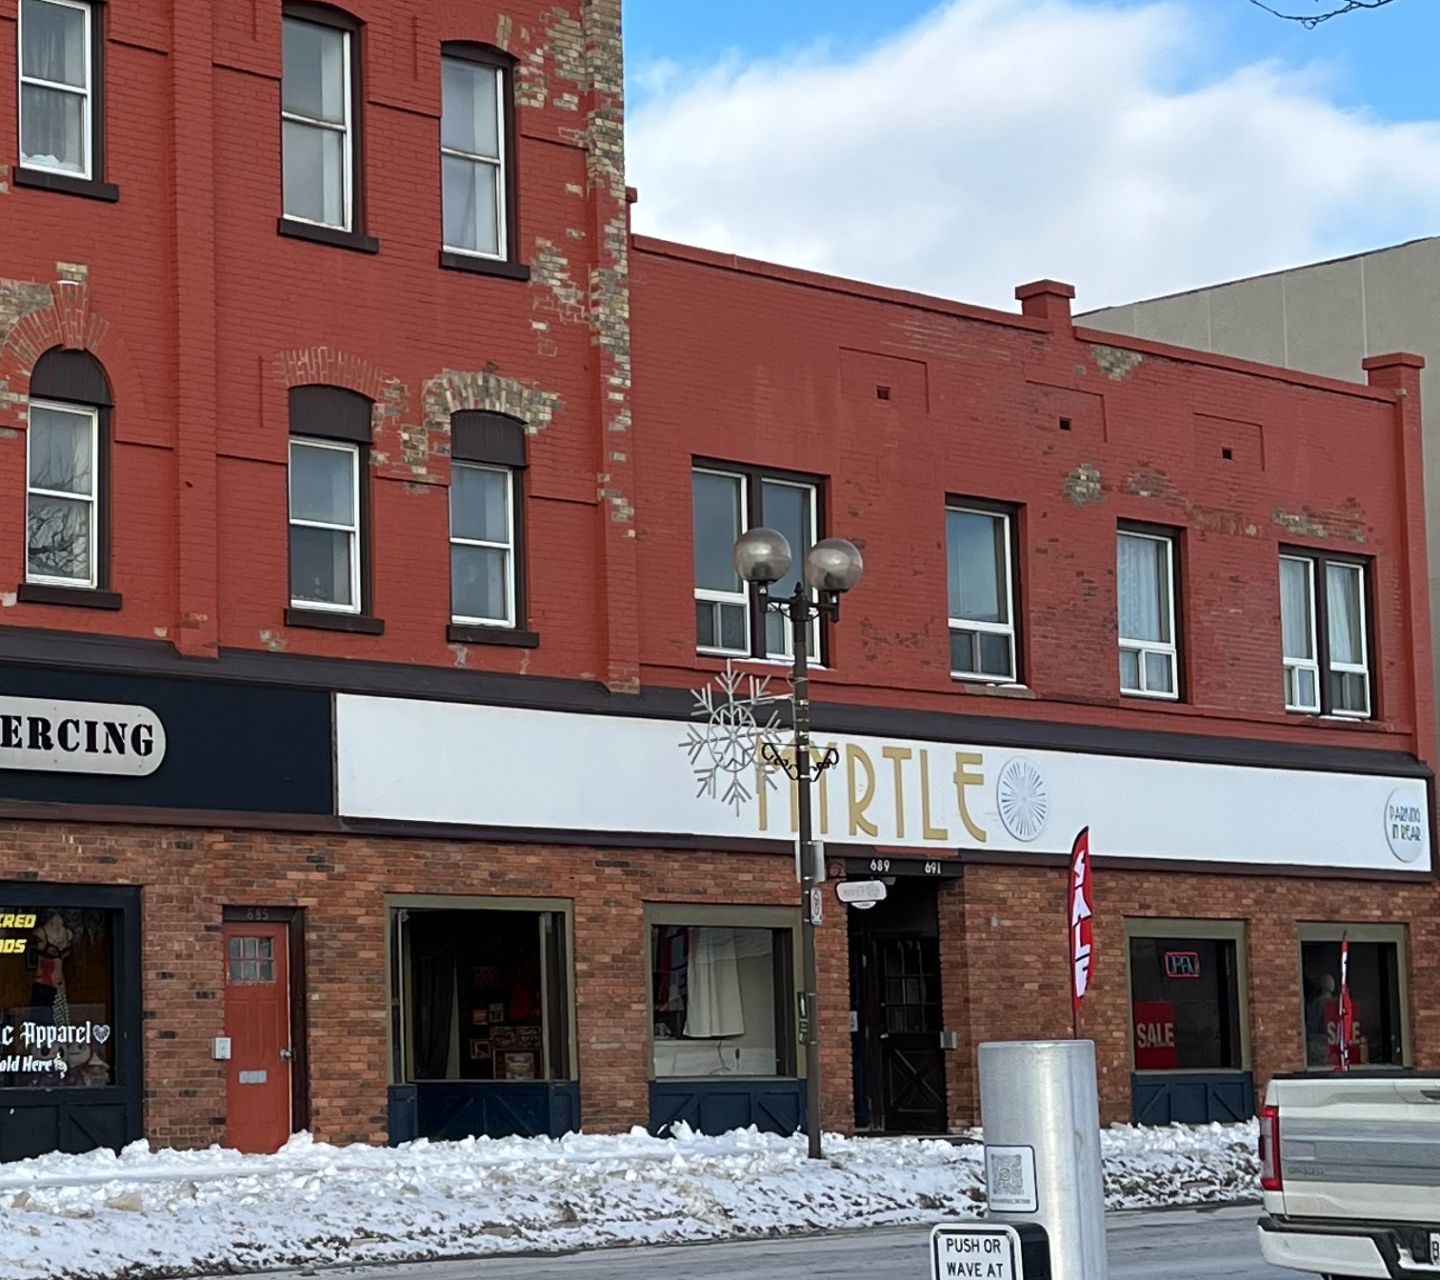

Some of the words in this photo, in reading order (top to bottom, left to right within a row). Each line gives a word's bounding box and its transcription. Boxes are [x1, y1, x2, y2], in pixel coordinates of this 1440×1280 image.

[870, 858, 890, 872] 689
[925, 861, 942, 874] 691
[20, 1021, 91, 1049] Apparel
[1137, 1022, 1176, 1048] SALE
[1327, 1021, 1361, 1045] SAE
[22, 1055, 54, 1073] Here
[946, 1238, 980, 1253] PUSH
[983, 1238, 1002, 1254] OR
[946, 1262, 983, 1277] WAVE
[986, 1263, 1003, 1278] AT
